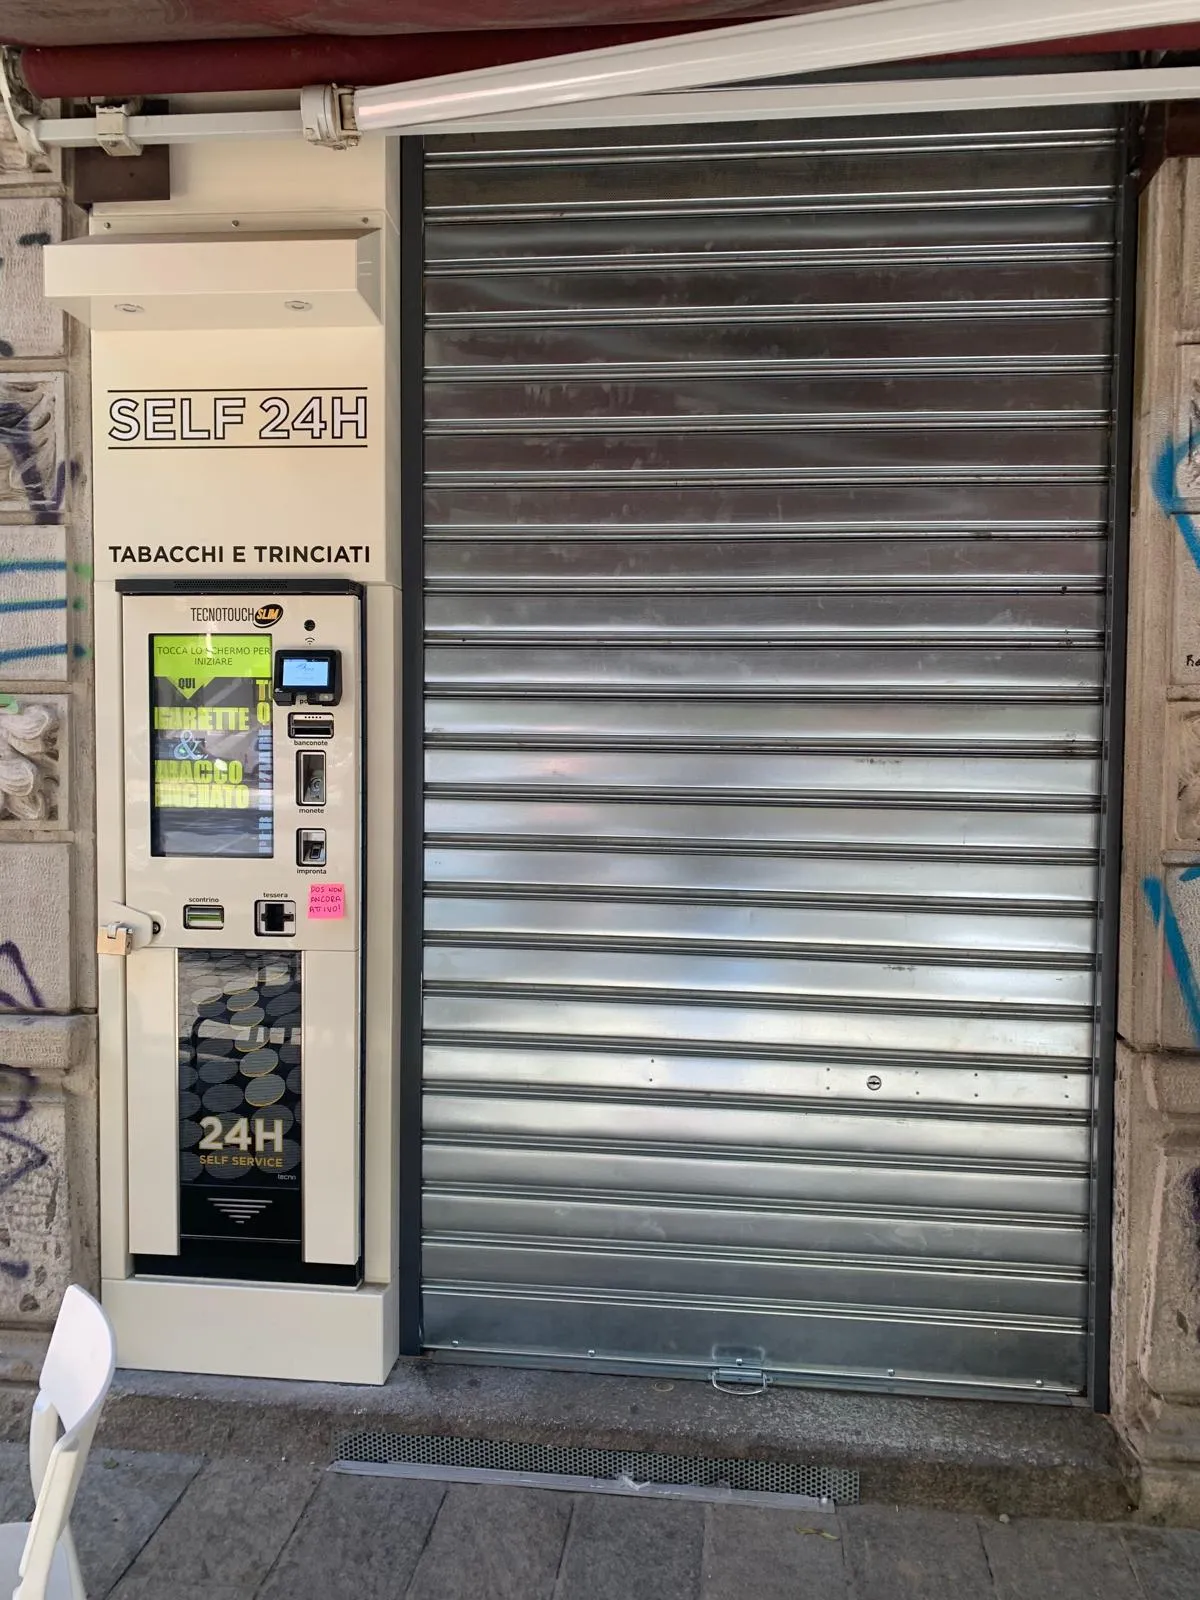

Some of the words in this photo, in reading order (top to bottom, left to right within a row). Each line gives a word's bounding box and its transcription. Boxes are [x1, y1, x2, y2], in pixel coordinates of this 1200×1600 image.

[108, 397, 246, 441] SELF
[259, 396, 368, 440] 24H
[108, 546, 224, 563] TABACCHI
[233, 546, 246, 562] E
[254, 545, 370, 563] TRINCIATI
[190, 607, 255, 622] TECNOTOUCH
[256, 608, 279, 620] SLIM
[157, 646, 188, 655] TOCCA
[191, 646, 202, 655] LO
[253, 647, 271, 655] PER
[194, 657, 233, 666] INIZIARE
[178, 678, 196, 689] QUI
[199, 1116, 283, 1152] 24H
[200, 1155, 229, 1165] SELF
[232, 1156, 283, 1168] SERVICE
